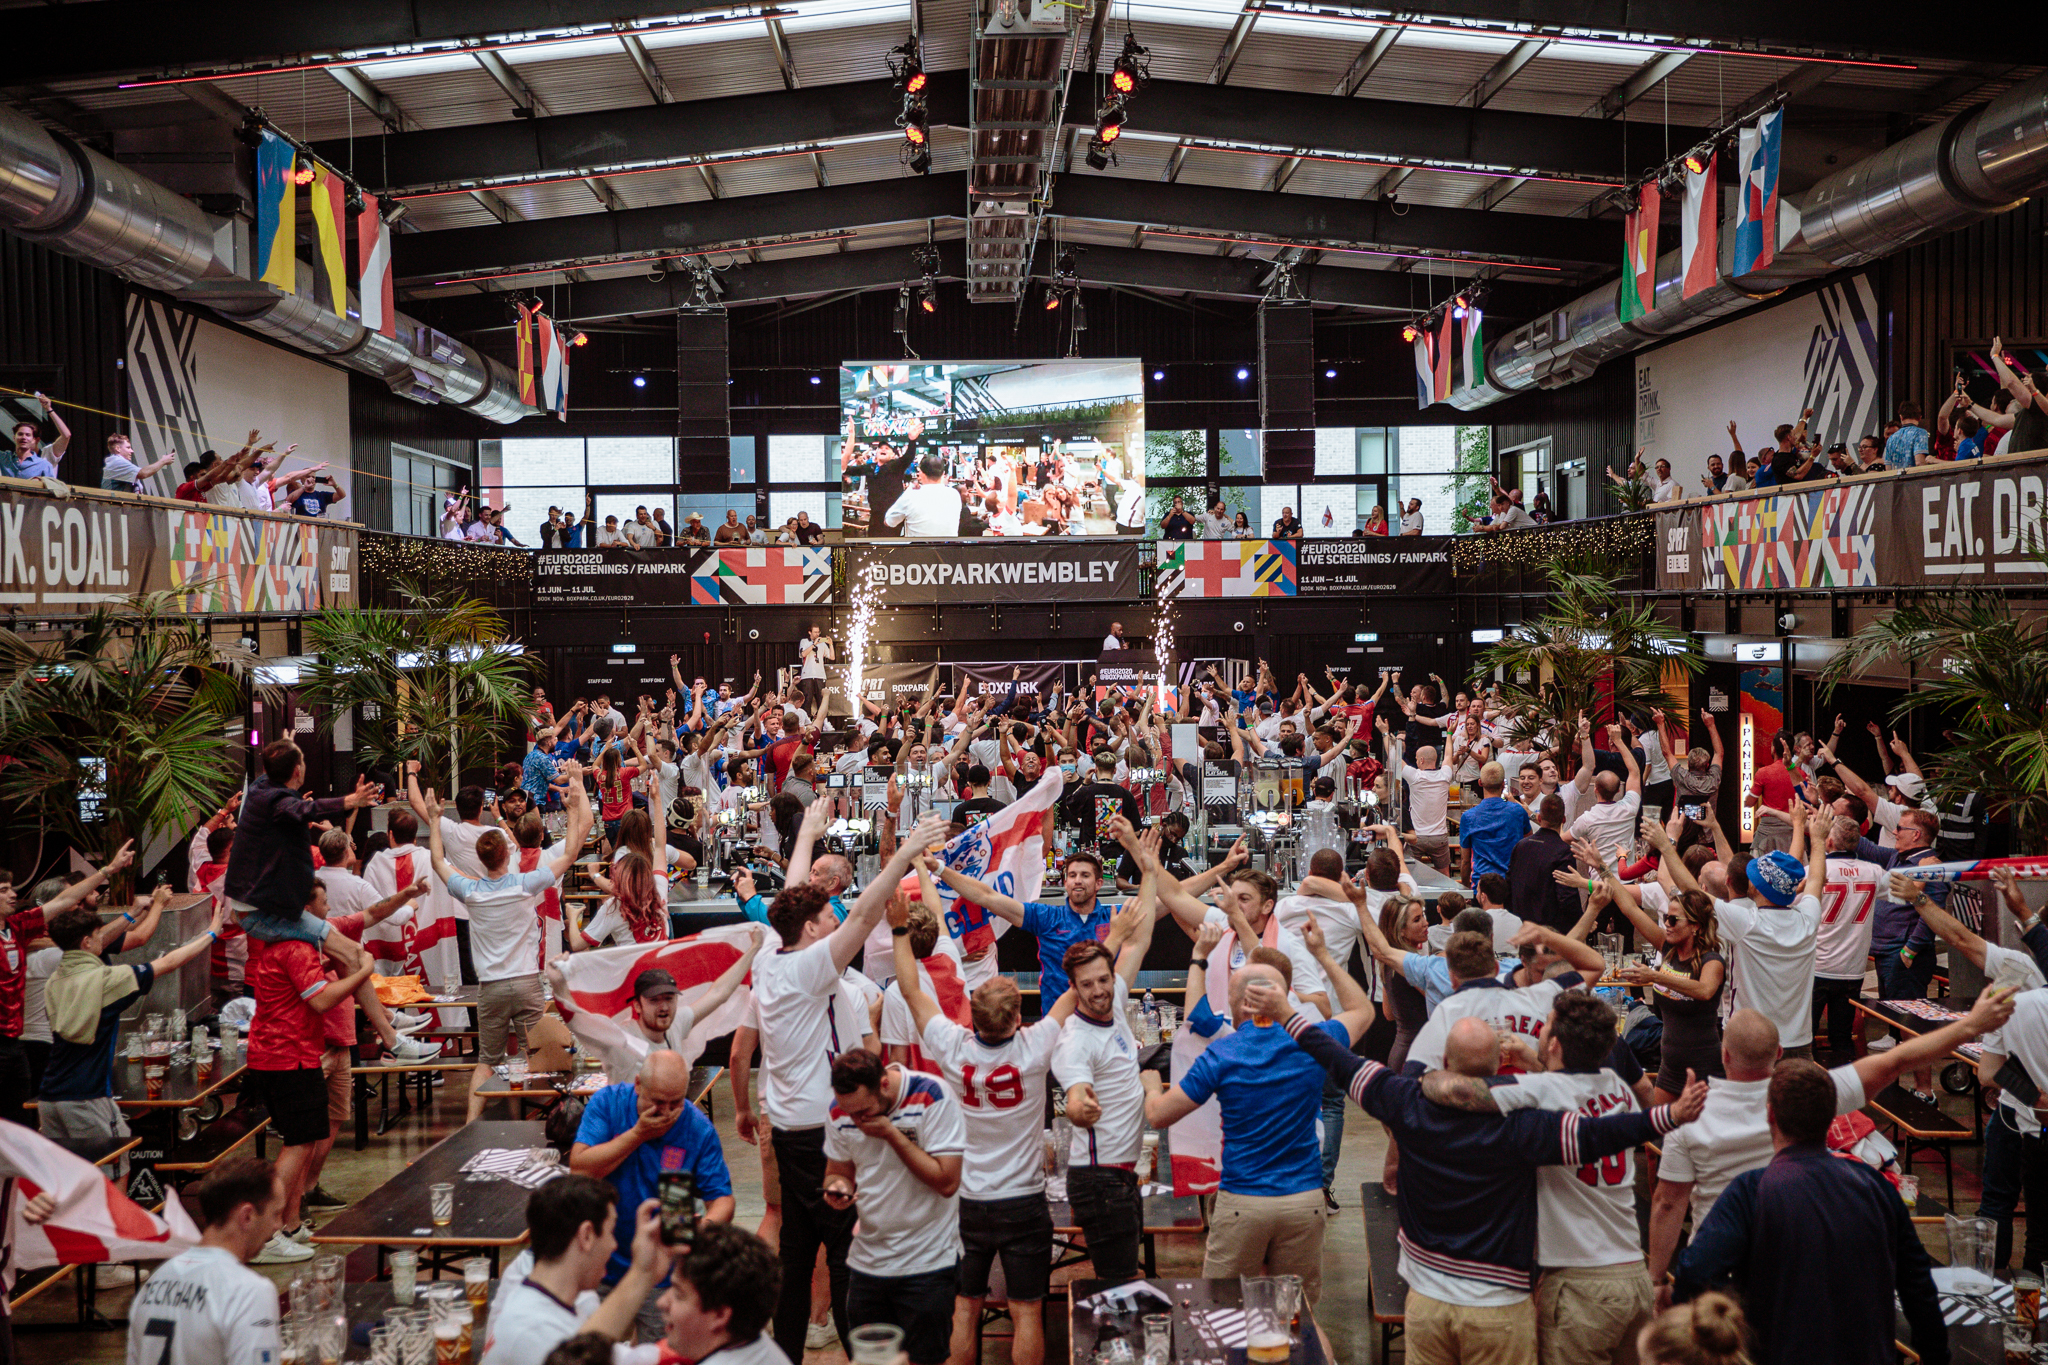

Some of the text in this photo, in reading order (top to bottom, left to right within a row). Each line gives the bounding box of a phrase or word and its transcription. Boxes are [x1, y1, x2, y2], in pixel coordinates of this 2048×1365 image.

[1639, 390, 1660, 415] DRINK.
[1923, 482, 1984, 557] EAT.
[42, 505, 129, 587] GOAL!
[1301, 543, 1366, 554] #EURO2020
[537, 554, 603, 565] #EURO2020
[1301, 552, 1448, 565] LIVE SCREENINGS / FANPARK
[538, 563, 686, 575] LIVE SCREENINGS / FANPARK
[869, 561, 1120, 586] @BOXPARKWEMBLEY
[892, 683, 930, 692] BOXPARK
[1839, 867, 1859, 876] TONY
[1822, 881, 1877, 924] 77
[960, 1061, 1026, 1111] 19
[130, 1150, 164, 1159] CAUTION
[143, 1318, 177, 1365] 7
